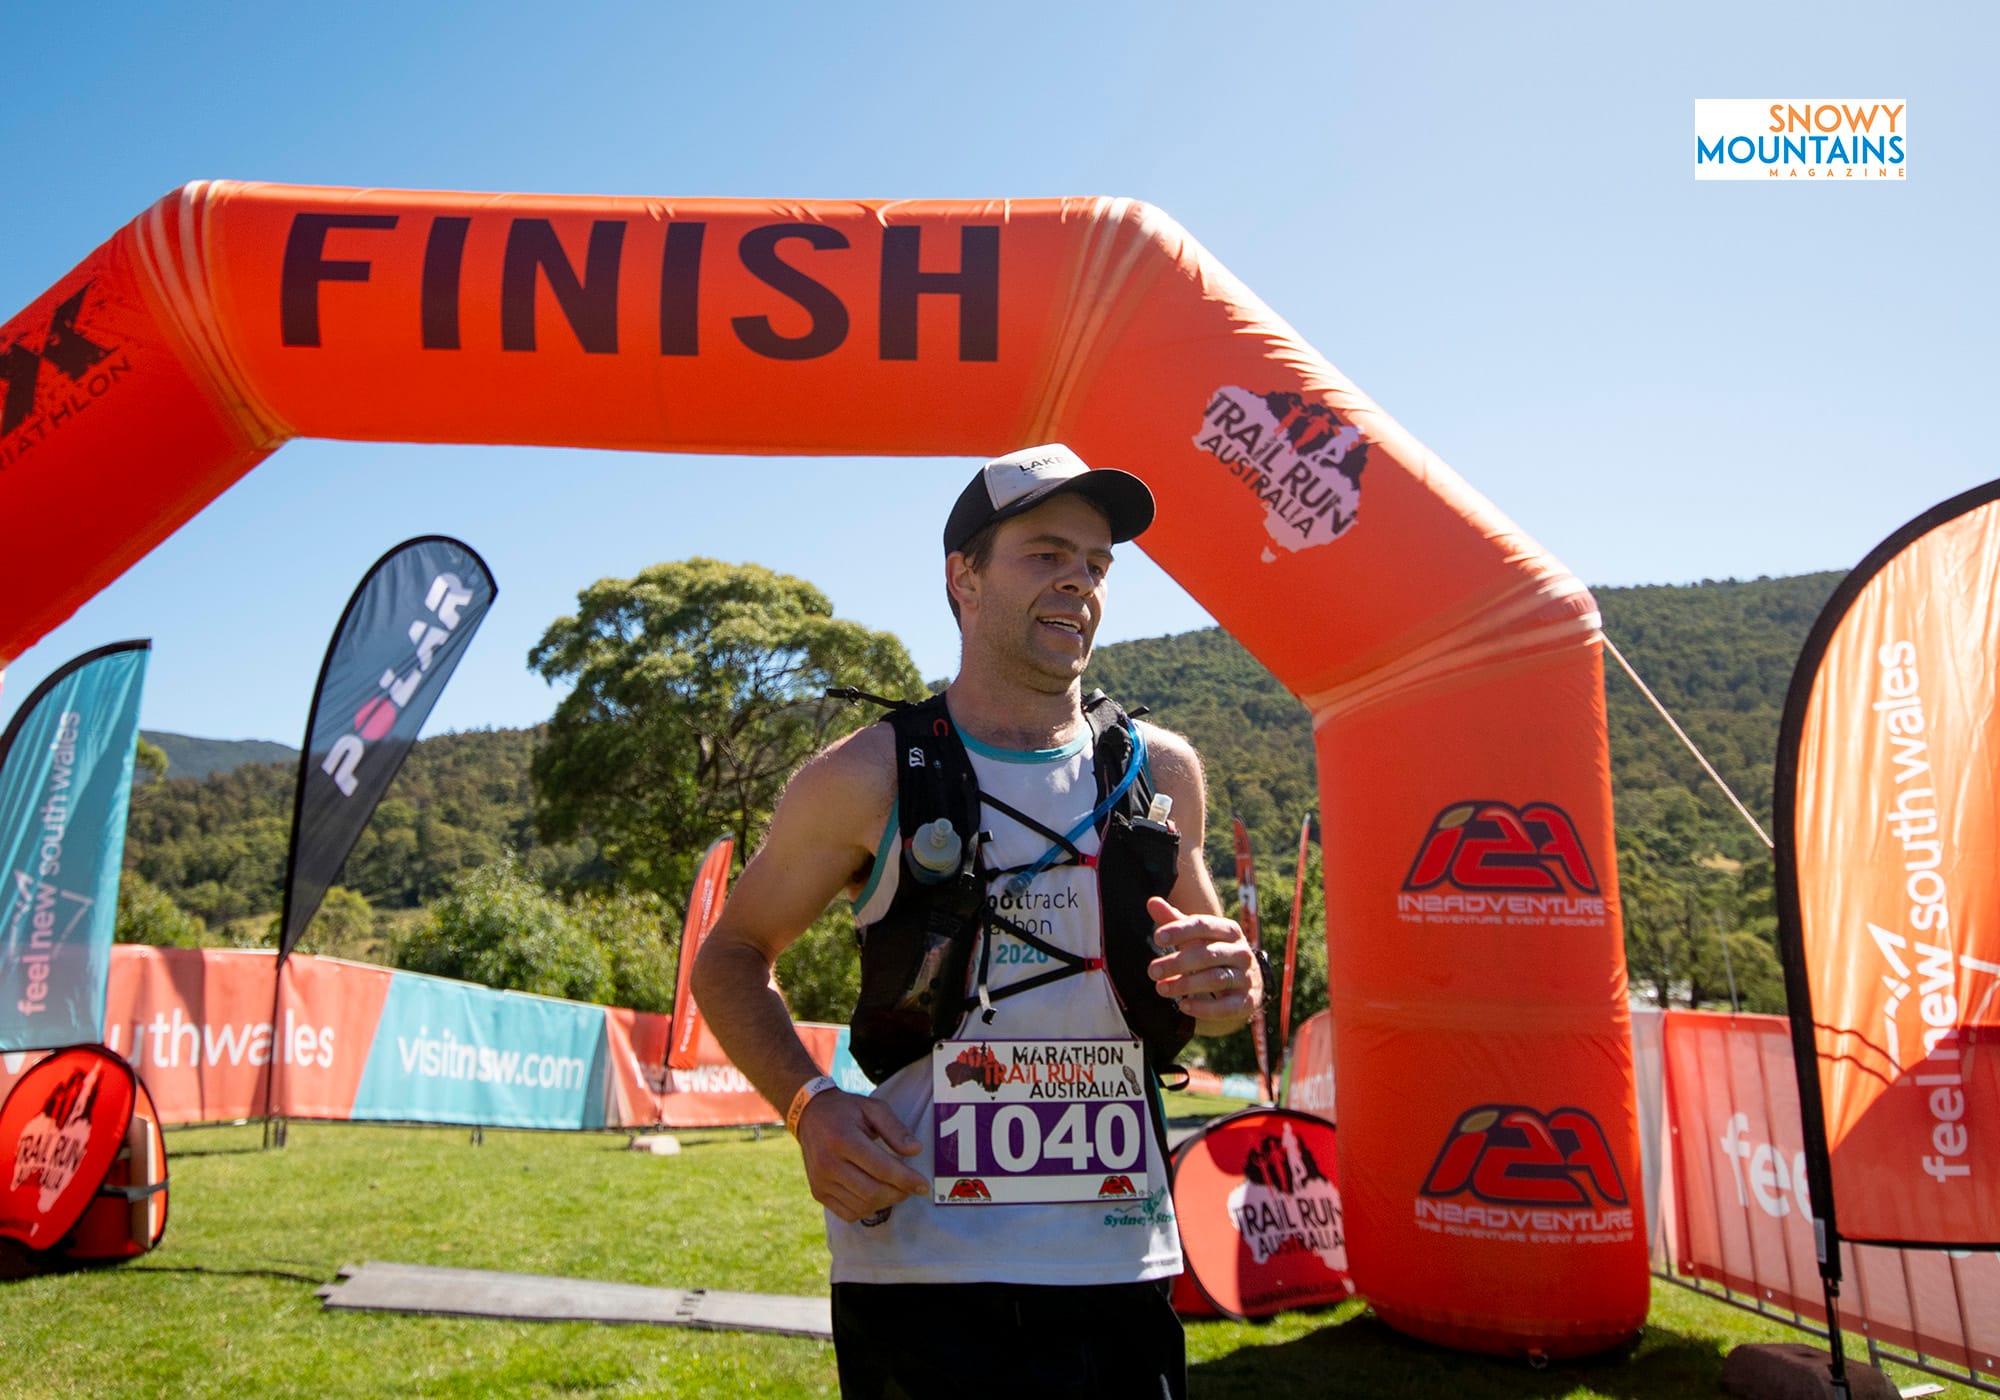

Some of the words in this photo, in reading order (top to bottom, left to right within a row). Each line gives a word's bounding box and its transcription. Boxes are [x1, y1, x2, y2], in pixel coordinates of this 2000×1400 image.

[280, 213, 999, 361] FINISH
[0, 355, 132, 471] IATHLON
[1201, 433, 1316, 539] AUSTRALIA
[1203, 391, 1285, 474] TRAIL
[1278, 460, 1359, 535] RUN
[321, 572, 474, 797] POLAR
[1872, 640, 1931, 784] wales
[49, 711, 80, 792] wales
[38, 794, 68, 876] south
[1887, 787, 1949, 931] south
[29, 882, 57, 950] new
[1397, 894, 1605, 916] IN2ADVENTURE
[17, 955, 49, 1016] feel
[1914, 942, 1961, 1061] new
[397, 1024, 585, 1089] visitnsw.com
[984, 1063, 1042, 1085] TRAIL
[1047, 1063, 1094, 1084] RUN
[1012, 1046, 1124, 1066] MARATHON
[1029, 1080, 1129, 1099] AUSTRALIA
[939, 1102, 1141, 1173] 1040
[1916, 1073, 1971, 1183] feel
[1233, 1200, 1297, 1237] TRAIL
[1414, 1198, 1634, 1231] IN2ADVENTURE
